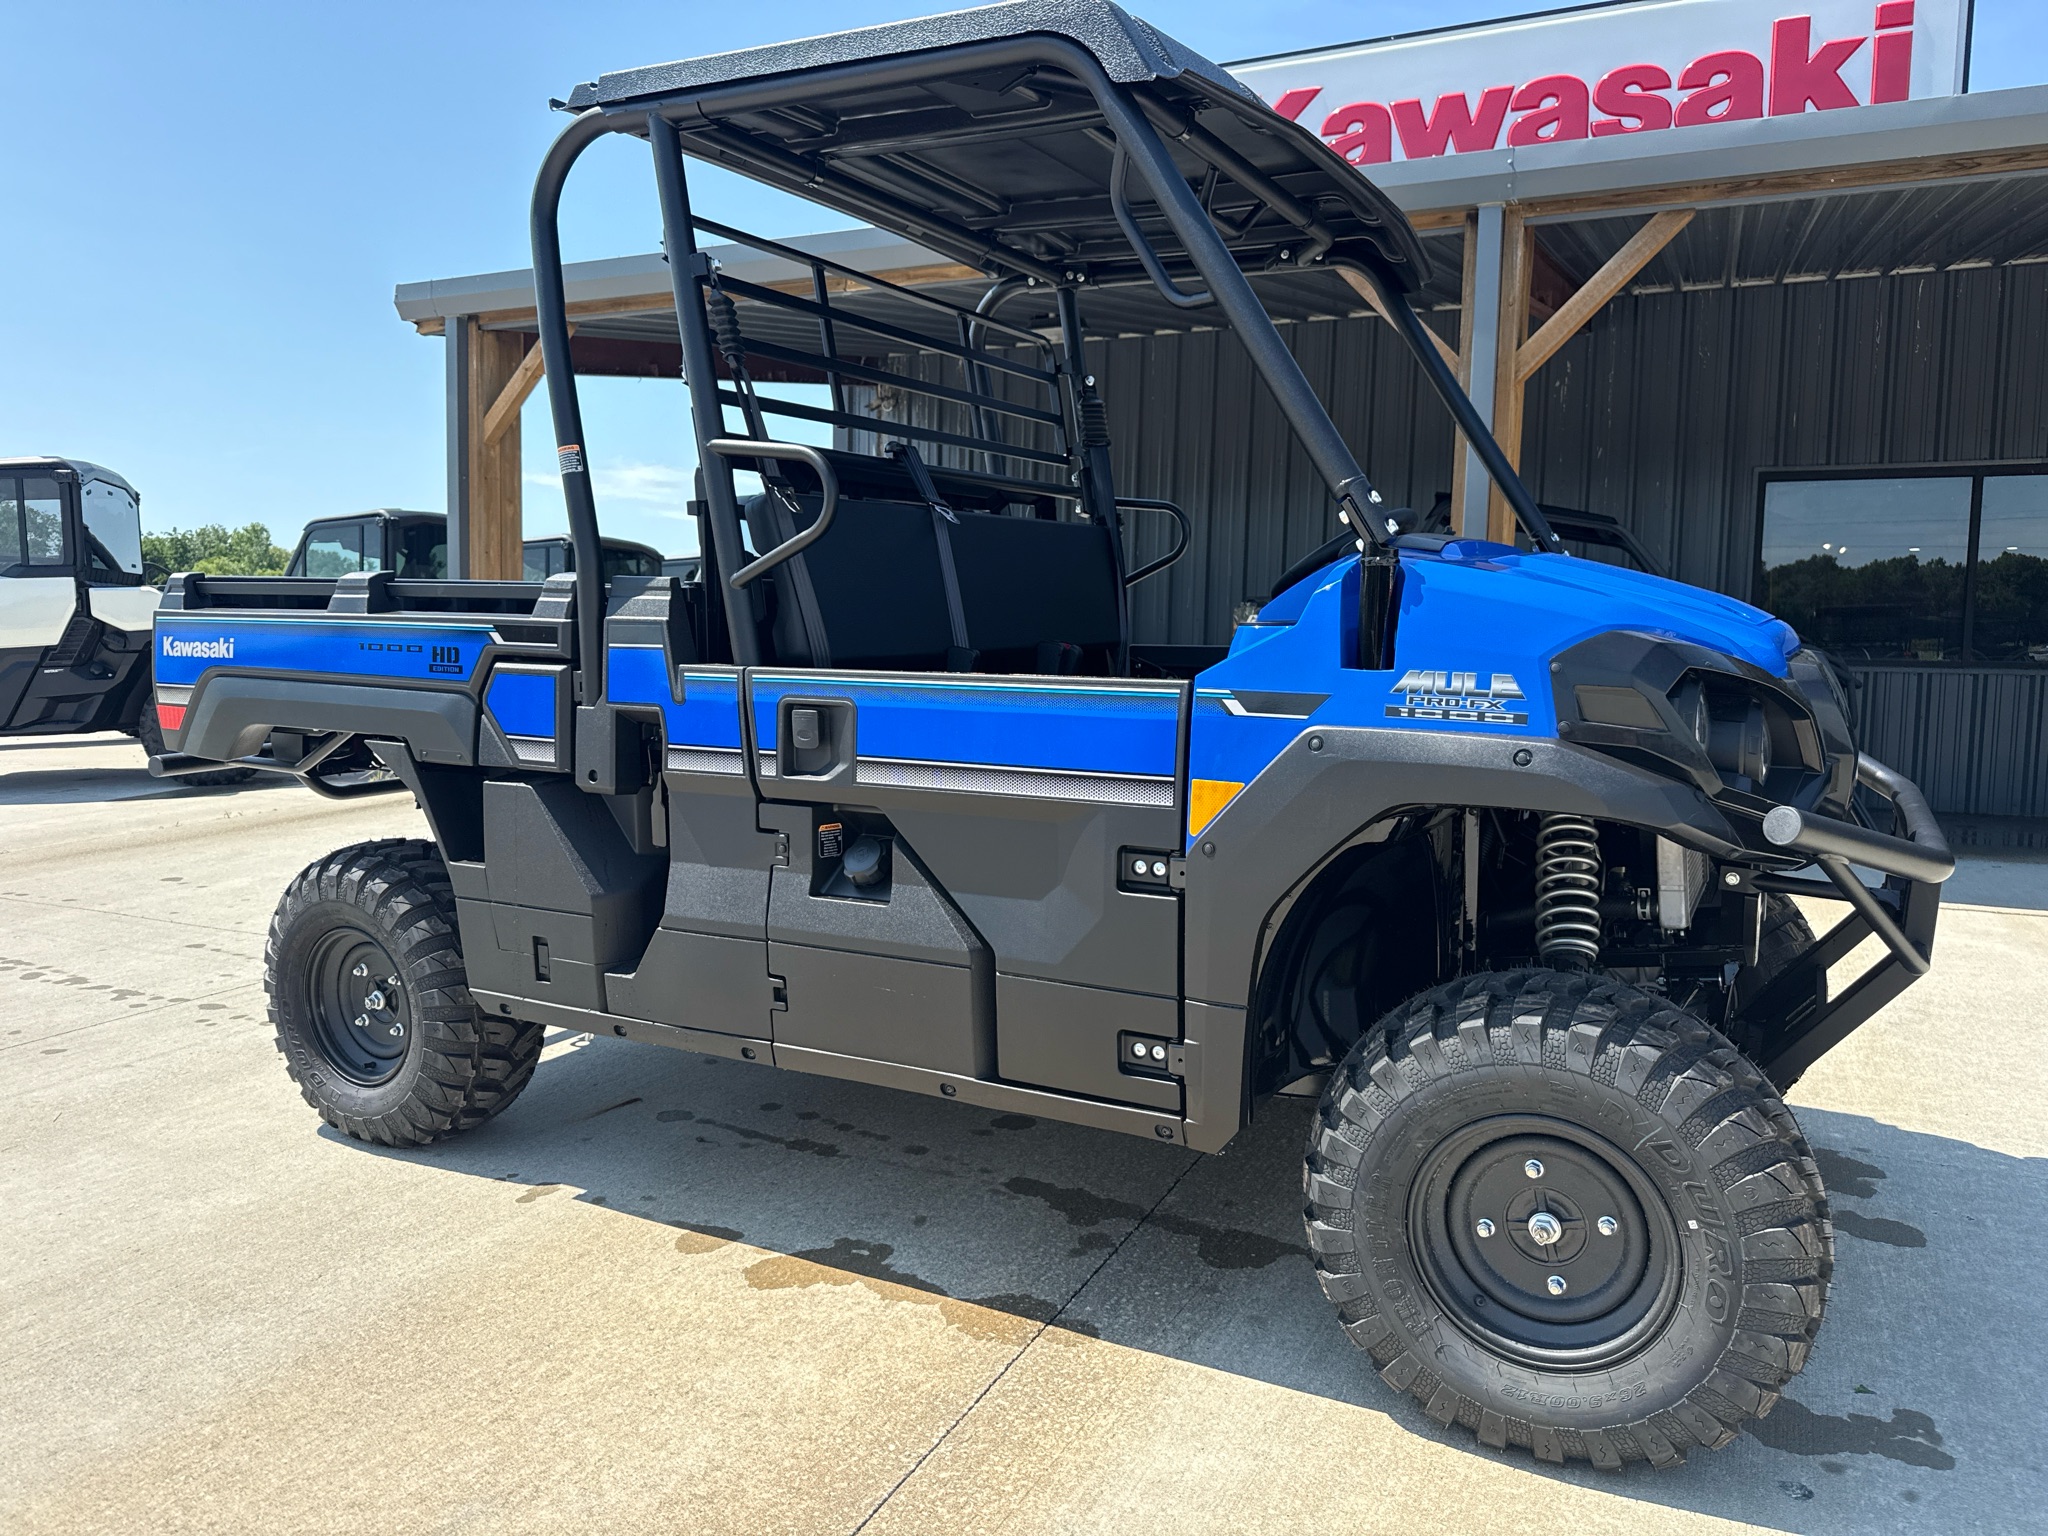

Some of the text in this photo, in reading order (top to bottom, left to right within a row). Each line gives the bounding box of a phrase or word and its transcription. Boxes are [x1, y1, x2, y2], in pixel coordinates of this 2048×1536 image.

[1258, 0, 1916, 166] awasaki
[162, 635, 234, 659] Kawasaki
[359, 642, 423, 653] 1000
[432, 646, 460, 664] HD
[432, 665, 460, 673] EDITION
[1390, 670, 1526, 699] MULE
[1398, 707, 1515, 723] 1000
[1646, 1140, 1733, 1326] DURO
[1366, 1171, 1434, 1342] FRONTIER
[1500, 1381, 1647, 1410] 26x9.00R12
